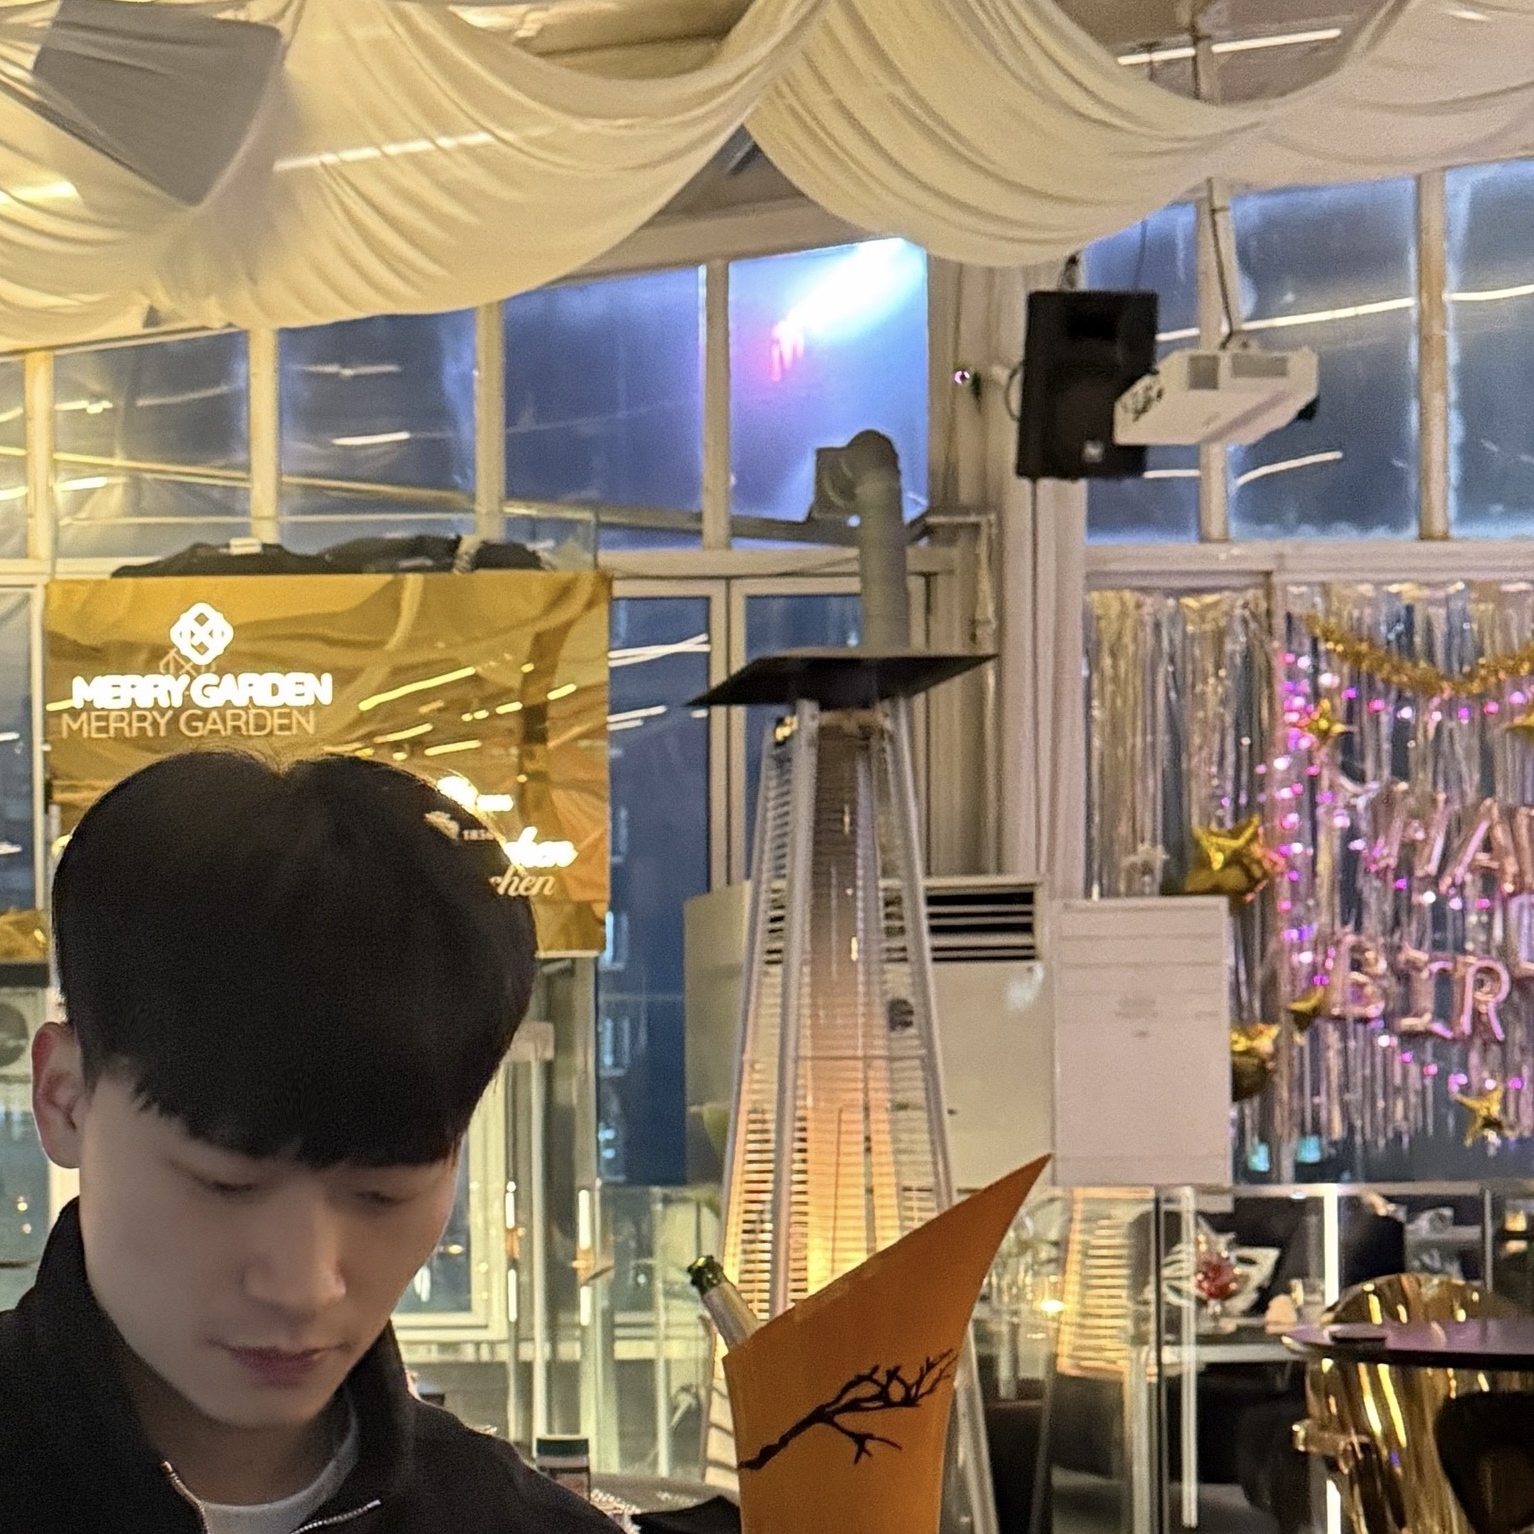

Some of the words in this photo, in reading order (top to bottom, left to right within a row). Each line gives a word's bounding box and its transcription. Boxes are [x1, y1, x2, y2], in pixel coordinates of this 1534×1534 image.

[72, 674, 190, 709] MERRY
[190, 672, 333, 708] GARDEN
[61, 711, 173, 738] MERRY
[179, 708, 315, 737] GARDEN
